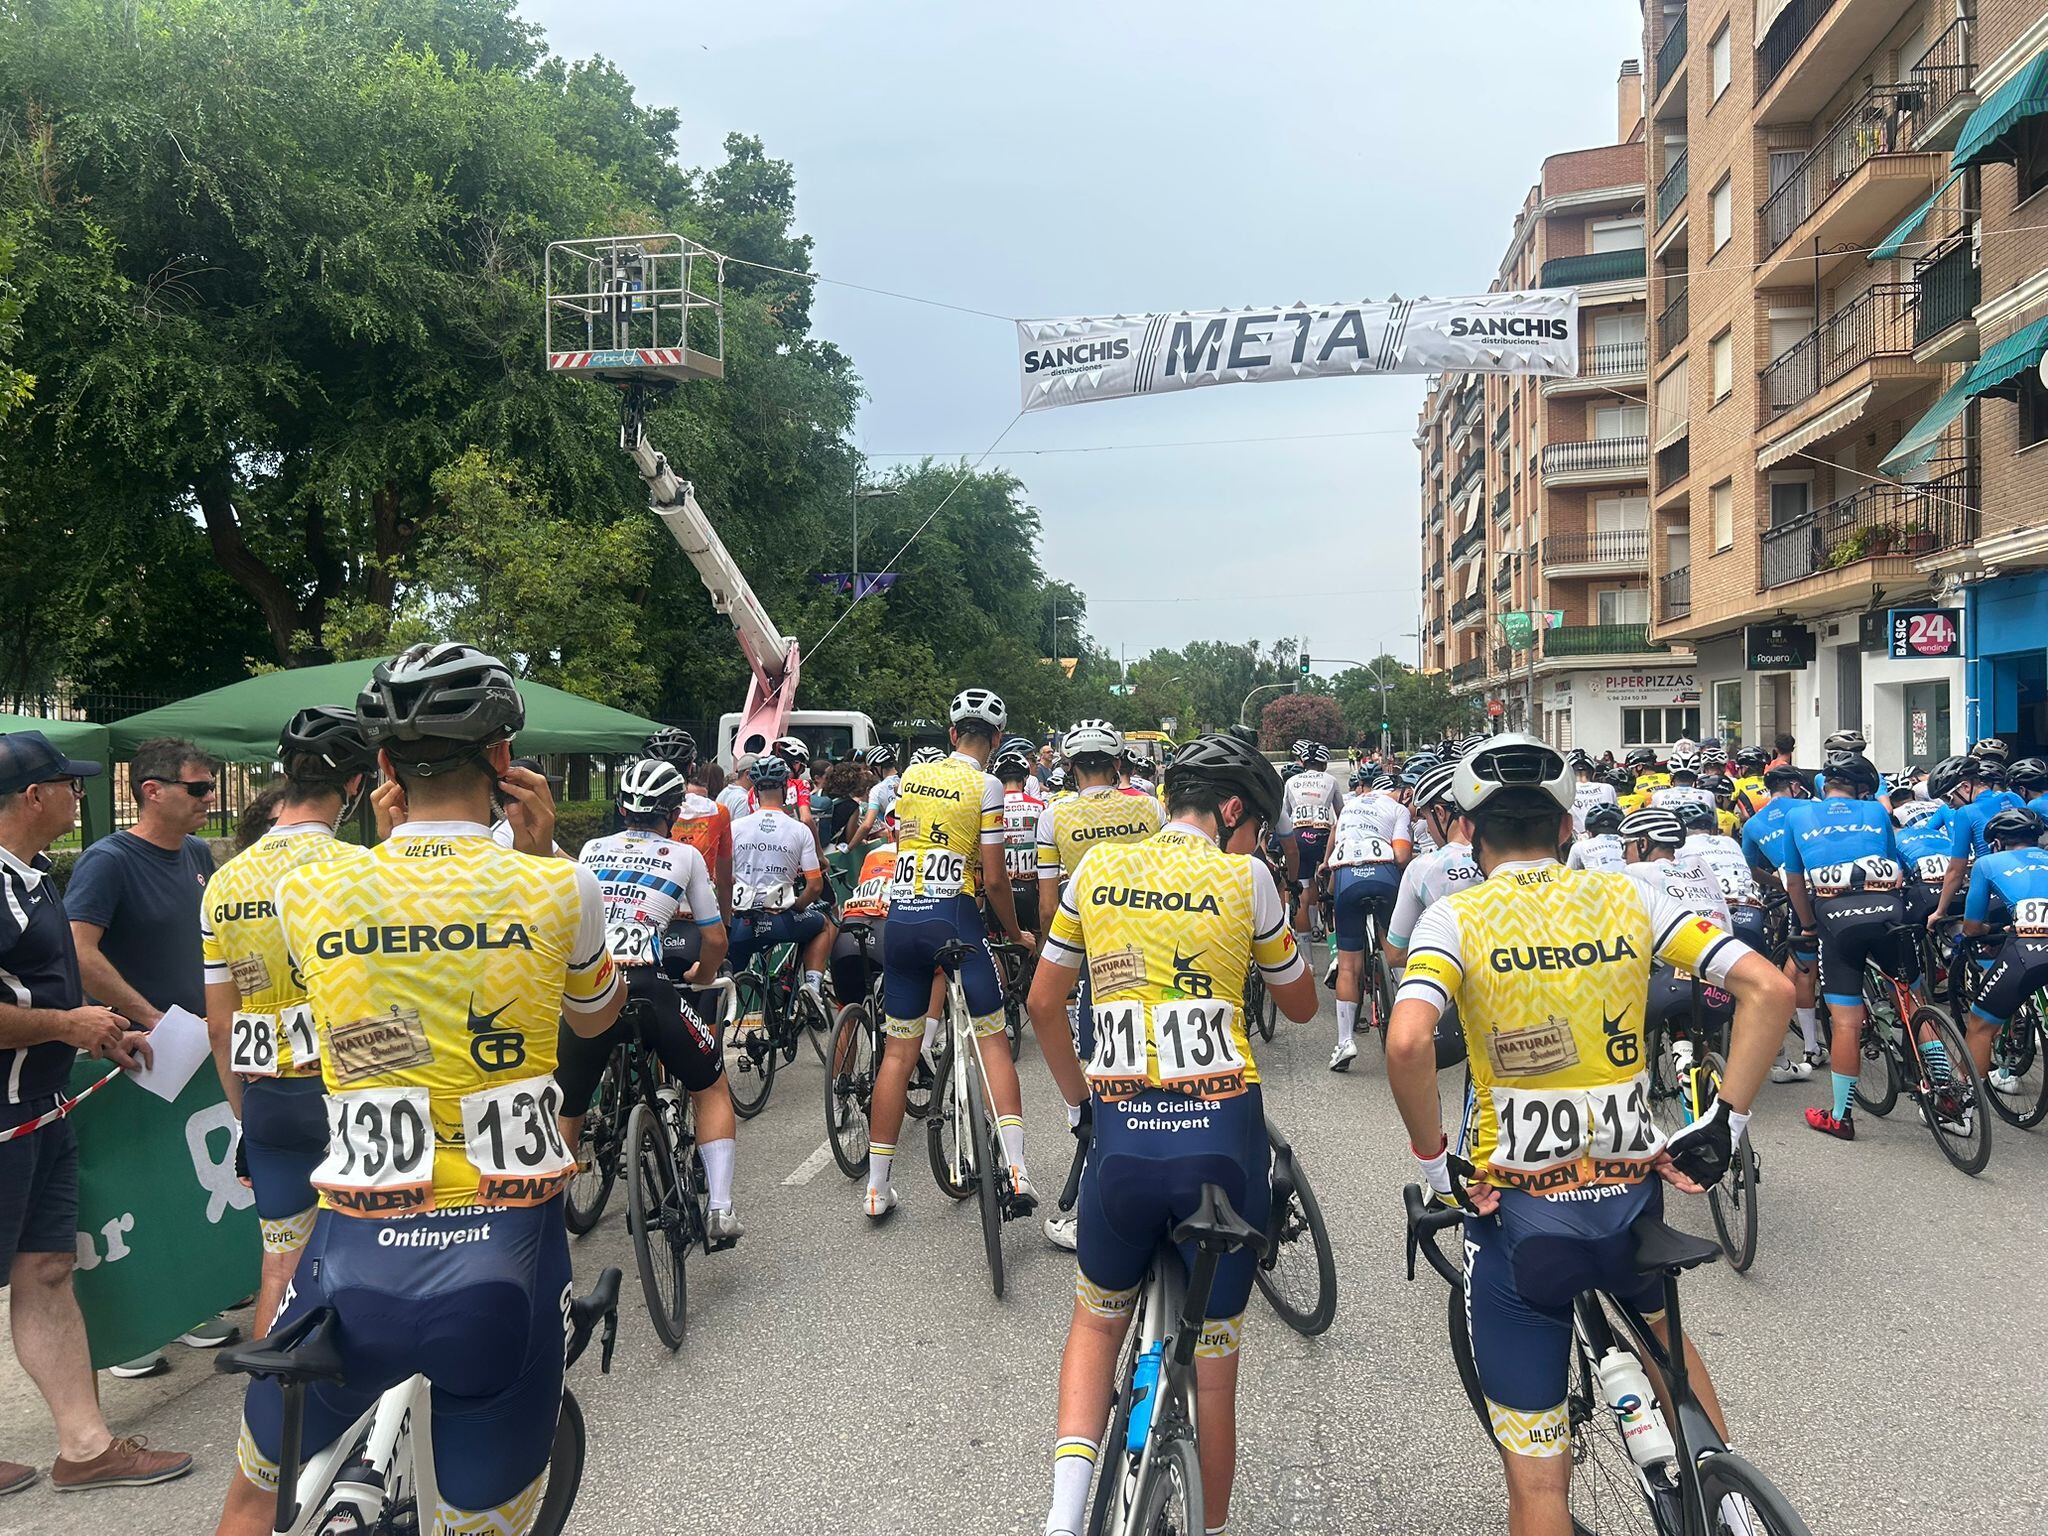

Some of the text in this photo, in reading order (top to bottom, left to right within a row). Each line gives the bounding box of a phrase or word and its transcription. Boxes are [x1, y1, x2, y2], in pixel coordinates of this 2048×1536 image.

[1450, 317, 1568, 340] SANCHIS
[1165, 309, 1370, 376] META
[1024, 338, 1130, 374] SANCHIS
[1050, 363, 1103, 376] distribuciones
[1895, 619, 1907, 656] BÀSIC
[1917, 644, 1949, 653] vending
[1296, 806, 1308, 819] 50
[1071, 822, 1149, 842] GUEROLA
[1801, 824, 1882, 841] WIXUM
[405, 844, 456, 857] ULEVEL
[1371, 839, 1382, 857] 8
[582, 855, 673, 872] JUAN GINER
[925, 853, 963, 882] 206
[1867, 857, 1893, 878] 86
[1926, 856, 1944, 874] 81
[1515, 870, 1554, 886] ULEVEL
[733, 886, 744, 907] 3
[1091, 886, 1221, 916] GUEROLA
[1827, 905, 1893, 920] WIXUM
[316, 922, 534, 960] GUEROLA
[612, 926, 643, 956] 23
[663, 936, 686, 948] Gala
[1489, 935, 1638, 974] GUEROLA
[1977, 960, 2009, 1002] WIXUM
[292, 1011, 316, 1055] 1
[680, 997, 715, 1050] vitaldin
[334, 1025, 405, 1051] NATURAL
[1163, 1007, 1234, 1069] 131
[1498, 1035, 1561, 1056] NATURAL
[1093, 1079, 1144, 1096] OWDEN
[1117, 1099, 1221, 1114] Club Ciclista
[477, 1086, 564, 1170] 130
[1126, 1116, 1210, 1132] Ontinyent
[1500, 1097, 1580, 1163] 129
[337, 1099, 426, 1177] 130
[1595, 1161, 1652, 1179] HOWD
[332, 1186, 425, 1212] OWDEN
[377, 1222, 491, 1251] Ontinyent
[1529, 1421, 1568, 1444] ULEVEL
